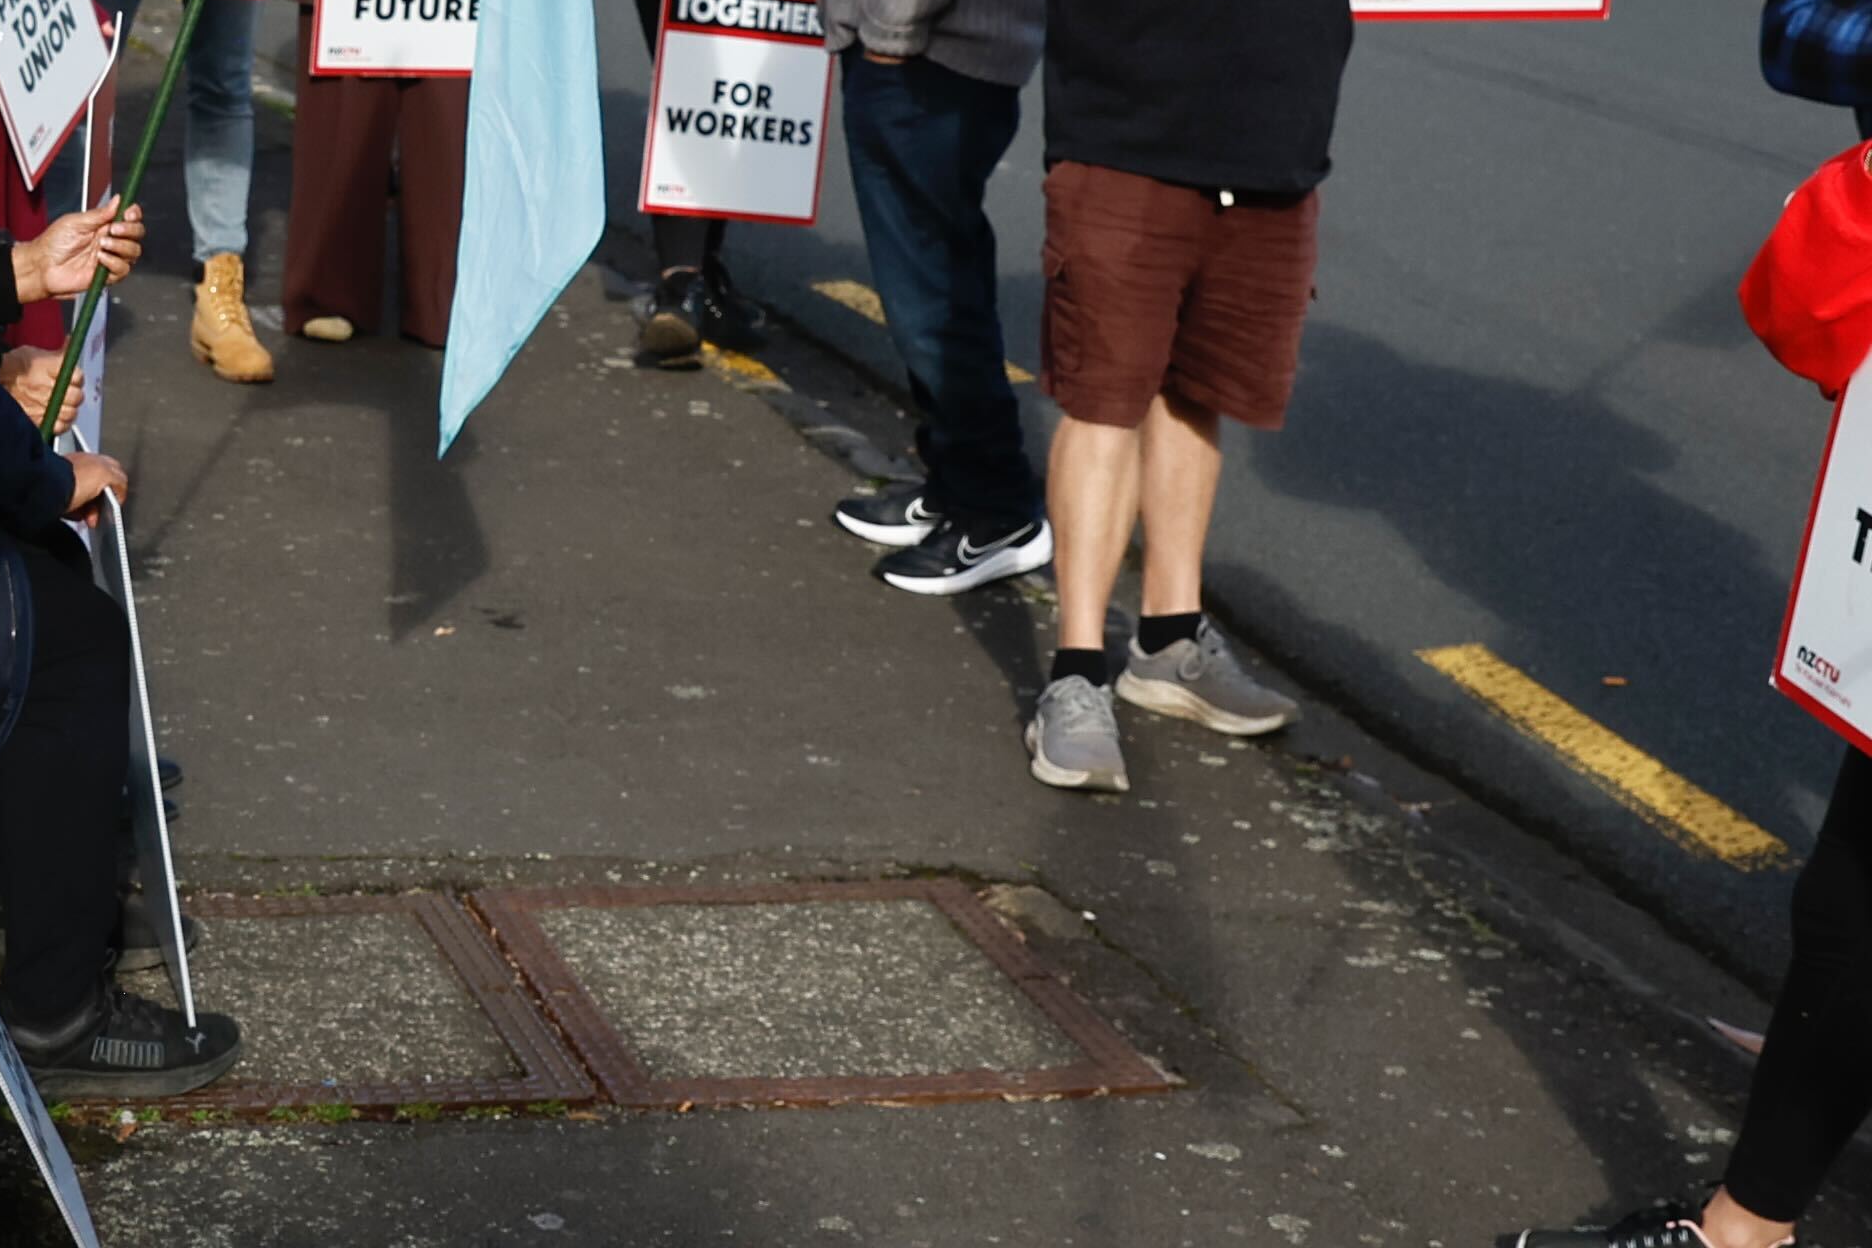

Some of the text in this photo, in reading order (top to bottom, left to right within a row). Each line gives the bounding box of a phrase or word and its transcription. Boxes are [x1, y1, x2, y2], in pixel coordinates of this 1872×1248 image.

[12, 4, 38, 50] TO
[18, 0, 77, 94] UNION
[712, 79, 773, 110] FOR
[665, 106, 814, 147] WORKERS
